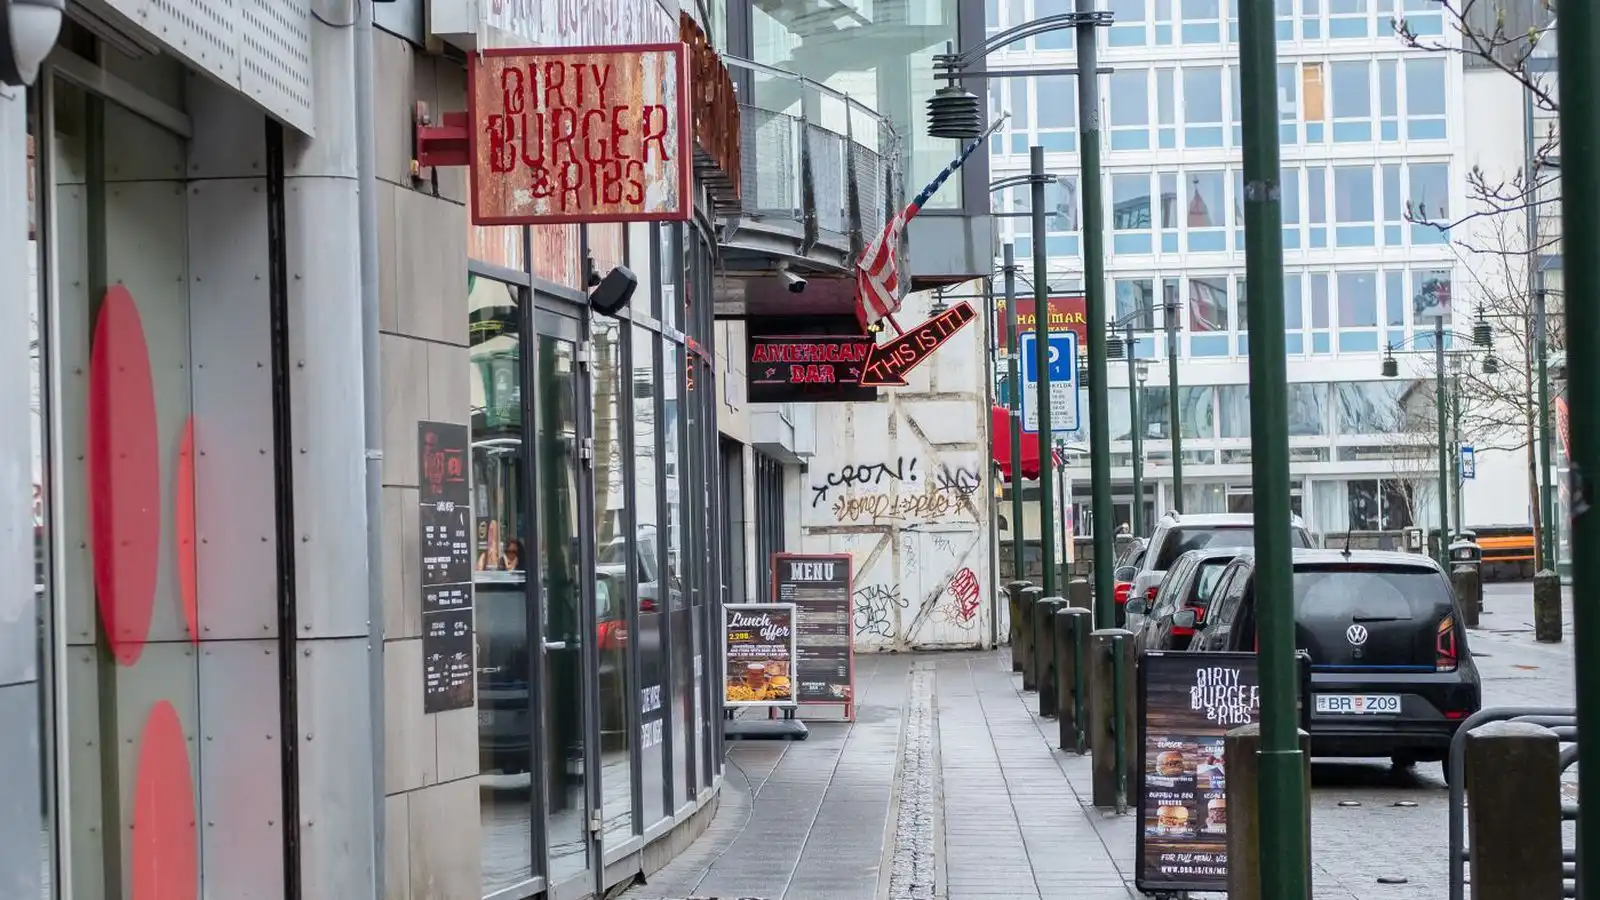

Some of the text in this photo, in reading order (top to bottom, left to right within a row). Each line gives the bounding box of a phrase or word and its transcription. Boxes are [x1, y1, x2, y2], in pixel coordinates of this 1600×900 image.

[501, 60, 613, 114] DIRTY
[486, 104, 669, 173] BURGER
[530, 159, 644, 213] & RIBS
[752, 343, 868, 363] AMERICAN
[867, 343, 917, 380] THIS
[915, 329, 937, 351] IS
[790, 364, 835, 383] BAR
[791, 562, 834, 580] MENU
[727, 612, 771, 627] Lunch
[760, 624, 790, 641] offer
[1197, 667, 1240, 687] DIRTY
[1190, 685, 1260, 710] BURGER
[1328, 697, 1351, 710] BR
[1366, 697, 1398, 710] Z09
[1207, 705, 1251, 725] & RIBS
[1161, 853, 1176, 861] FOR
[1177, 853, 1192, 863] FULL
[1216, 854, 1228, 863] VIS
